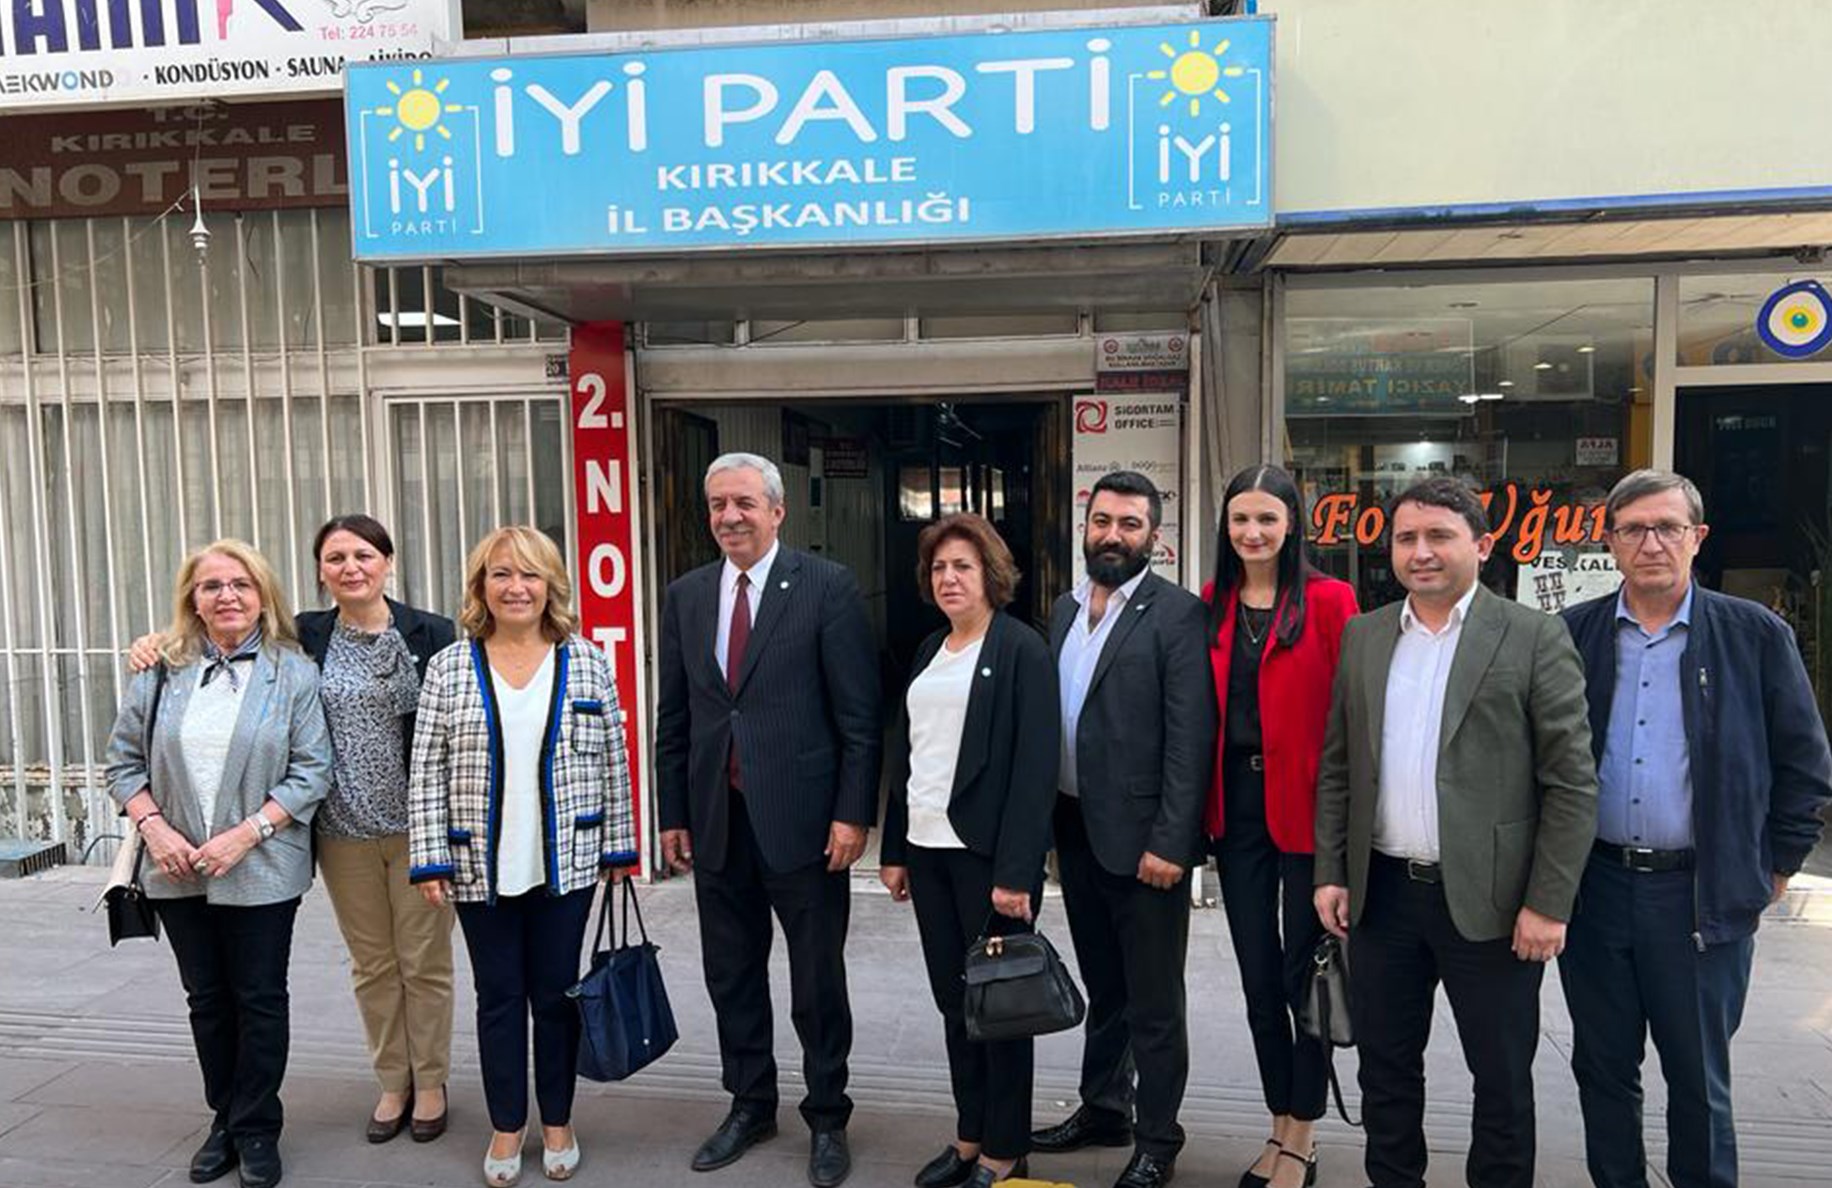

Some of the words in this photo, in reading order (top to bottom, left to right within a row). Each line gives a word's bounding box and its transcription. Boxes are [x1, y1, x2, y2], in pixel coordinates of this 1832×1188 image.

[350, 25, 375, 40] 224
[155, 58, 269, 85] KONDÜSYON
[490, 61, 647, 157] İYİ
[704, 38, 1112, 147] PARTİ
[52, 124, 317, 153] KIRIKKALE
[1158, 122, 1231, 183] İYİ
[389, 155, 455, 214] İYİ
[657, 156, 917, 190] KIRIKKALE
[1158, 187, 1231, 208] PARTİ
[391, 219, 457, 235] PARTİ
[608, 204, 647, 234] İL
[663, 192, 970, 235] BAŞKANLIĞI
[577, 372, 623, 429] 2.
[1114, 418, 1155, 430] OFFICE
